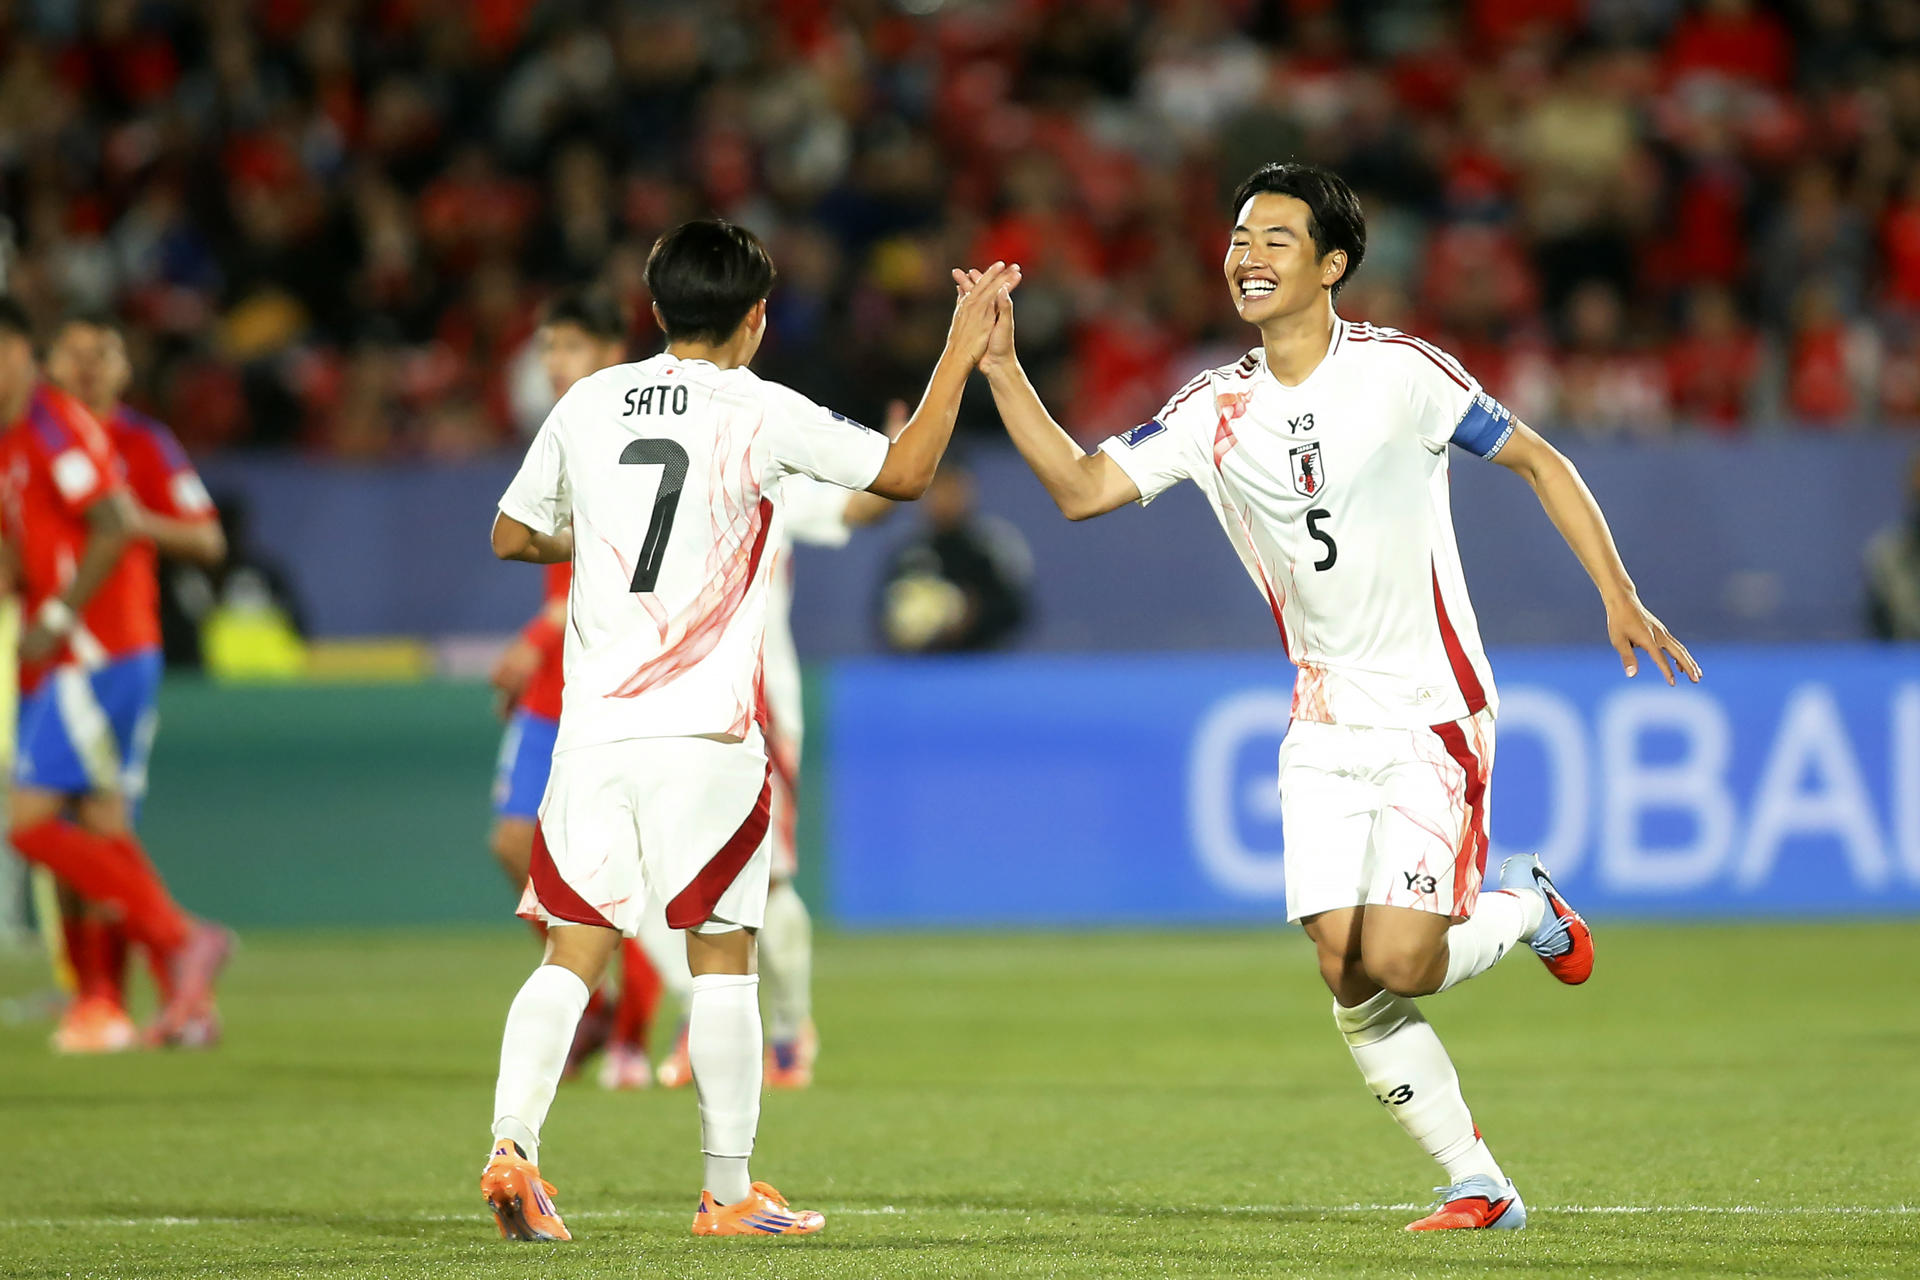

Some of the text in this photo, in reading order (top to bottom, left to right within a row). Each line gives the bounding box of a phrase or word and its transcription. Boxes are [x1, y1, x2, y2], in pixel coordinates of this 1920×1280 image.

[622, 384, 689, 417] SATO
[618, 438, 690, 593] 7
[1306, 508, 1338, 572] 5
